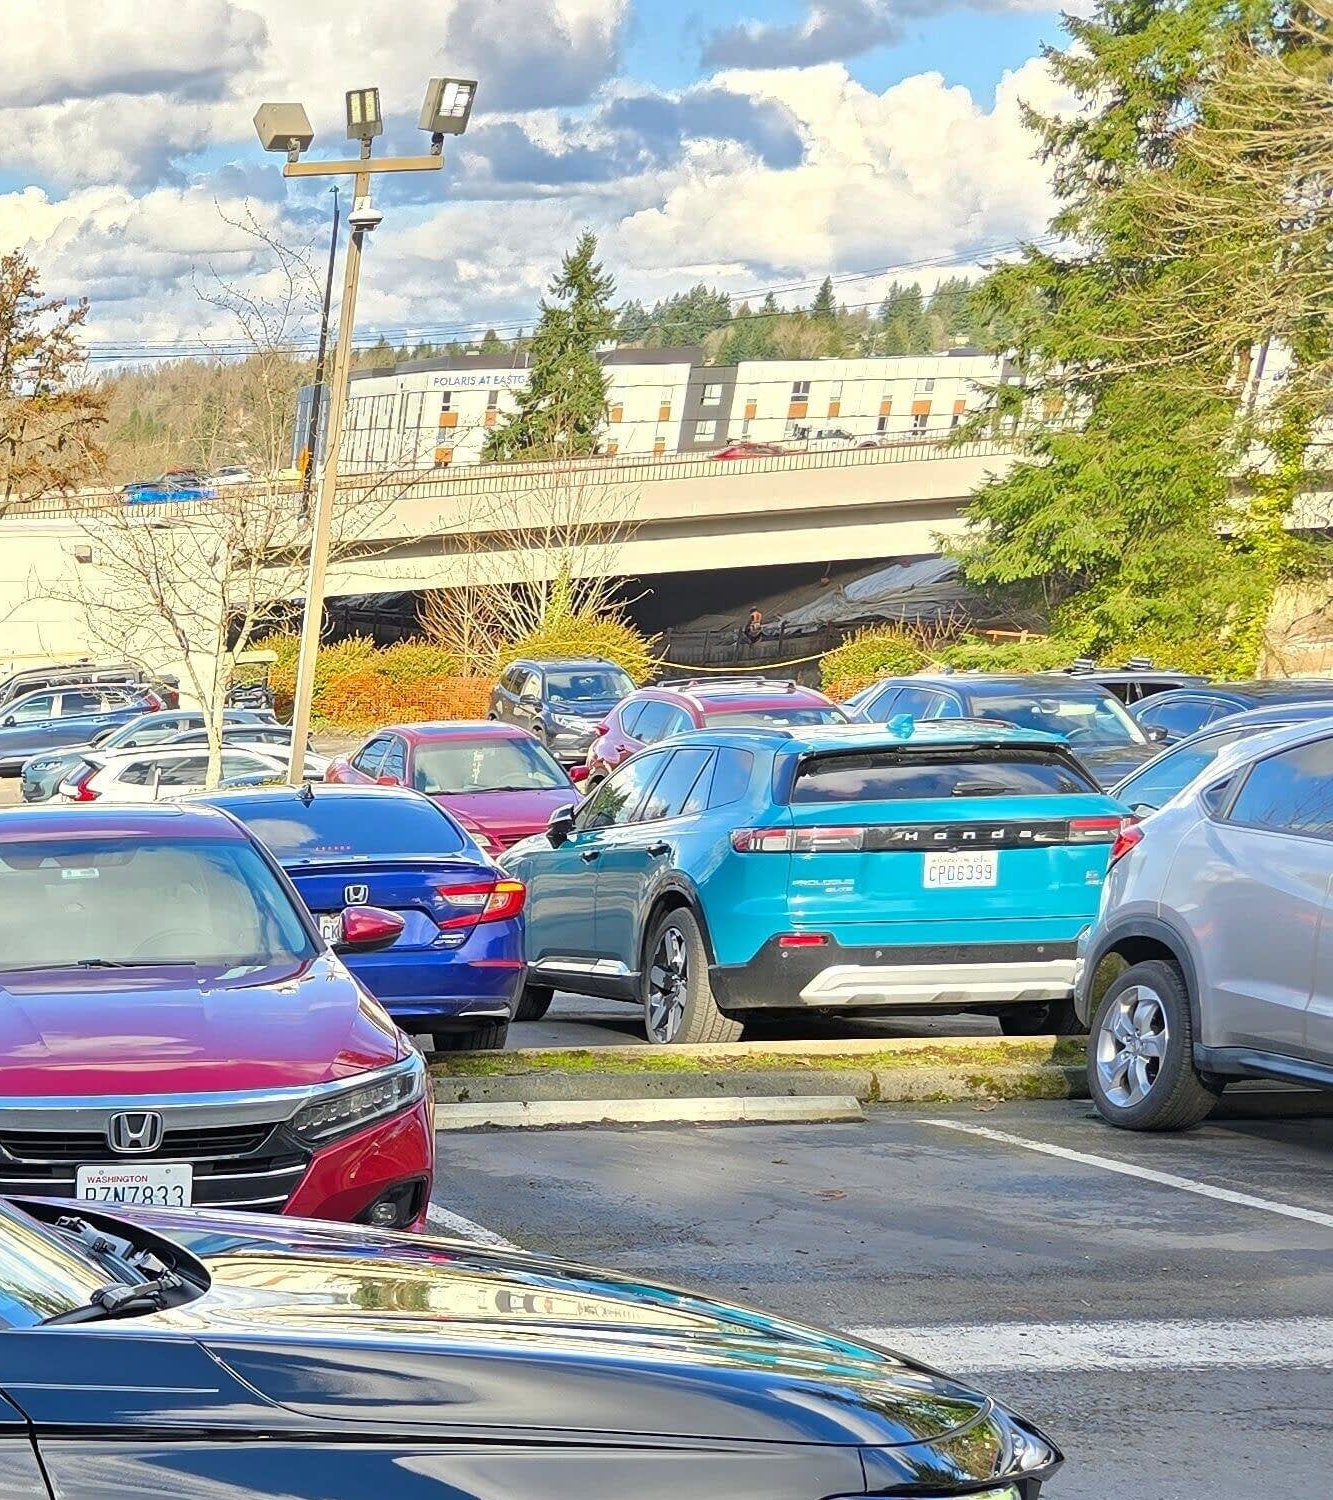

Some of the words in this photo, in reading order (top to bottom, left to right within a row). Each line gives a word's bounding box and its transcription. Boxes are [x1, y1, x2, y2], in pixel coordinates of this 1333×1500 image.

[434, 377, 476, 386] POLARIS
[478, 376, 491, 384] AT
[493, 375, 525, 384] EASTG
[87, 1175, 148, 1184] WASHINGTON
